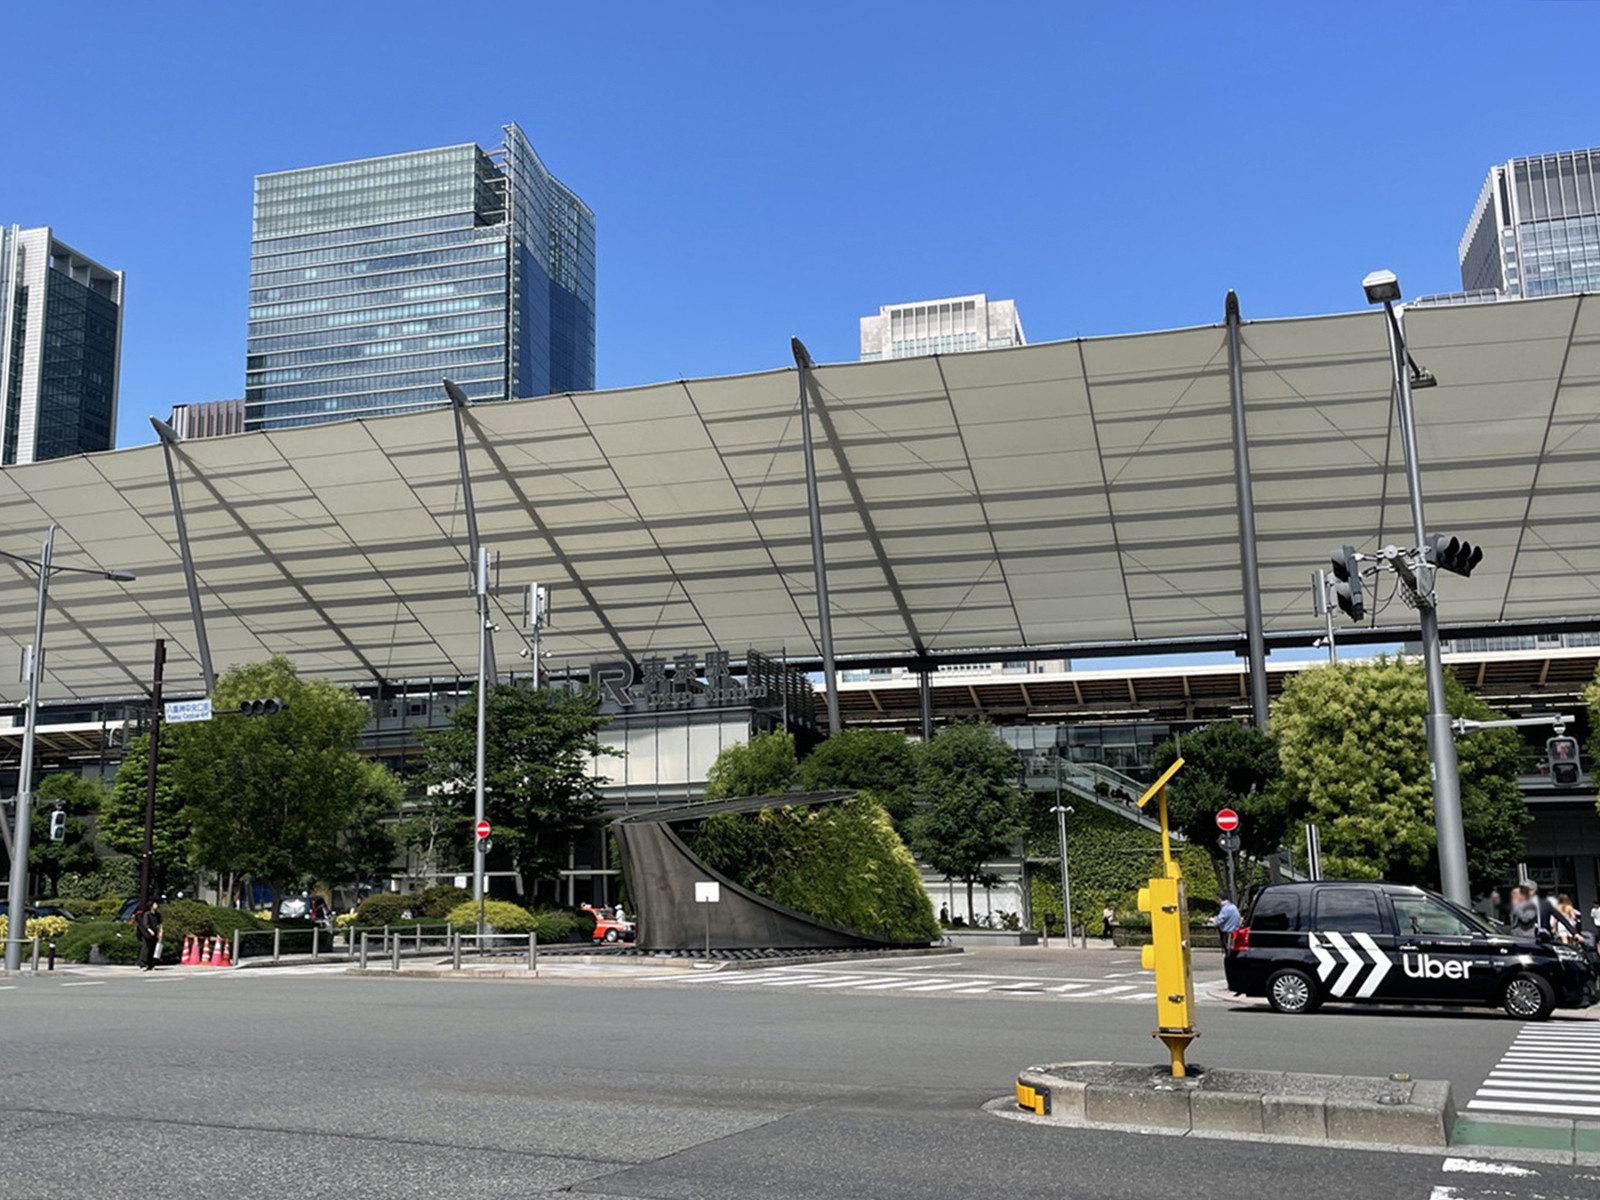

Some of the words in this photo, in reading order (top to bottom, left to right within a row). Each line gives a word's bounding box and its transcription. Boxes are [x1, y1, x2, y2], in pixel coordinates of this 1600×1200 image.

[641, 650, 730, 682] 東京駅
[1403, 954, 1473, 979] Uber
